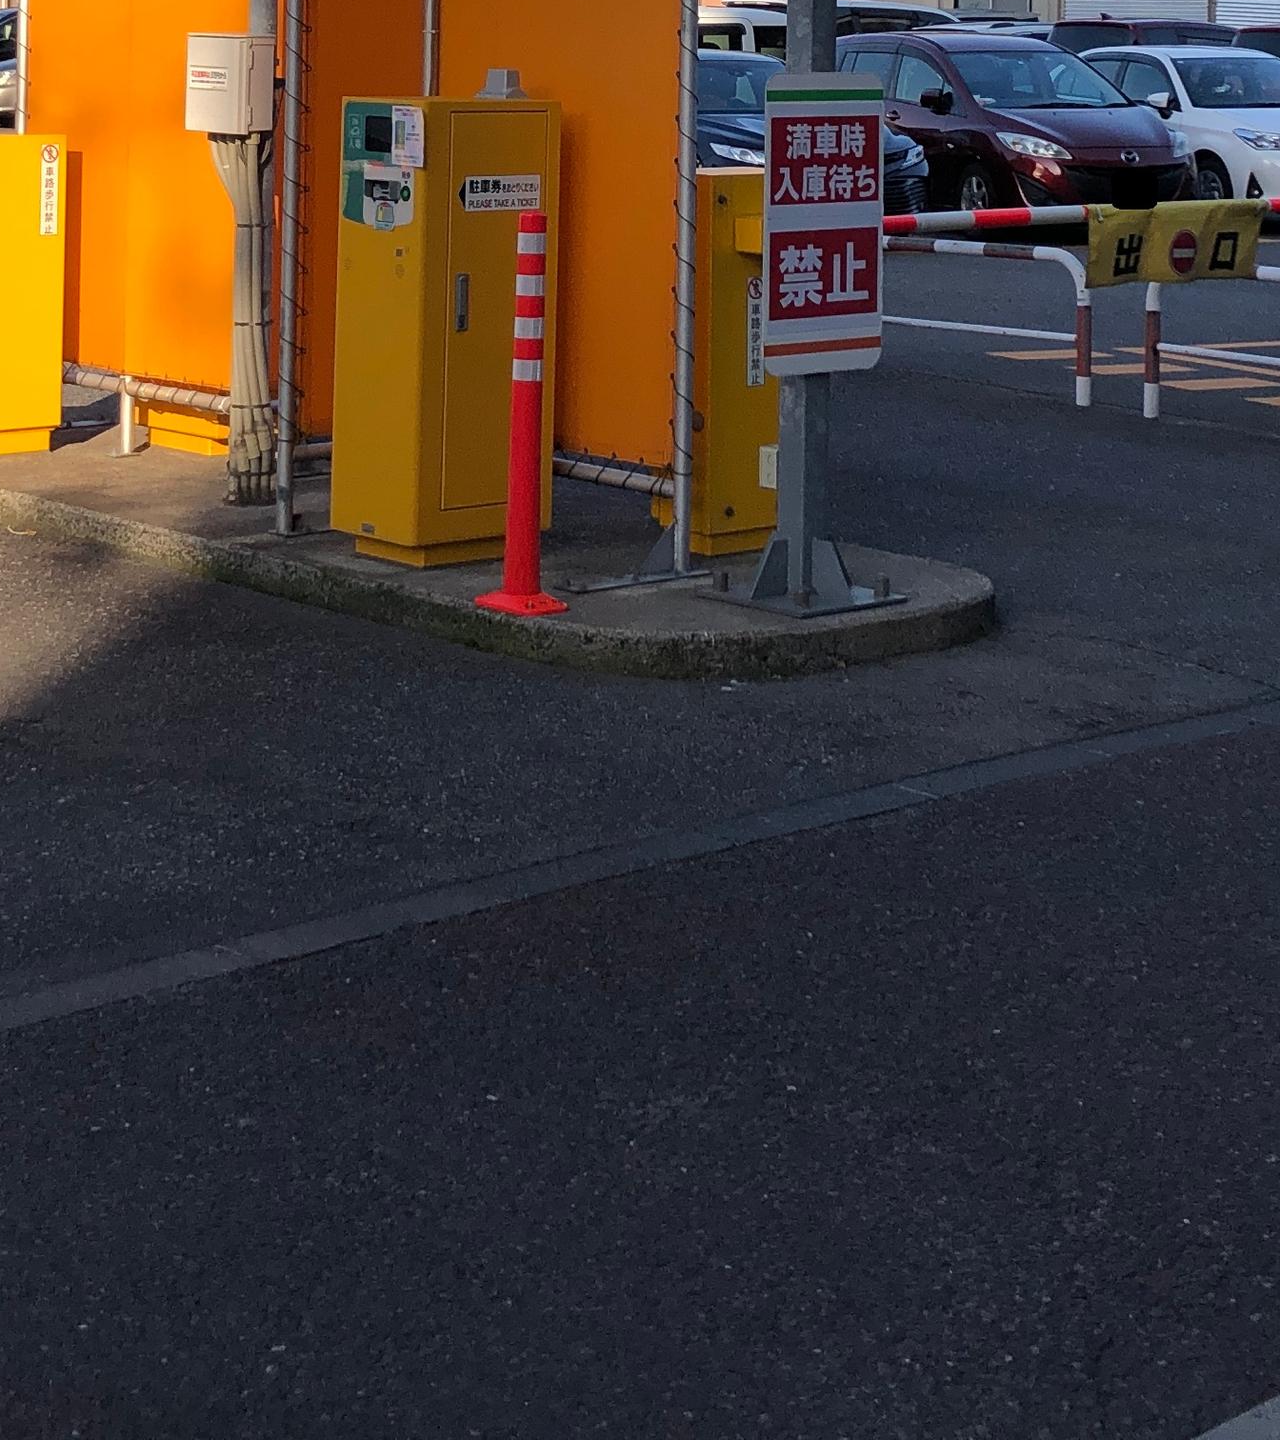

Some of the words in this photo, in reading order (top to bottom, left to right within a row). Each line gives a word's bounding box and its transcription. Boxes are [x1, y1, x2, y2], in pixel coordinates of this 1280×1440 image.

[786, 122, 866, 160] 満車時
[774, 163, 876, 203] 入庫待ち
[468, 199, 493, 209] PLEASE
[494, 199, 510, 208] TAKE
[517, 198, 538, 207] TICKET
[779, 242, 869, 309] 禁止
[751, 303, 761, 385] 車路歩行禁止
